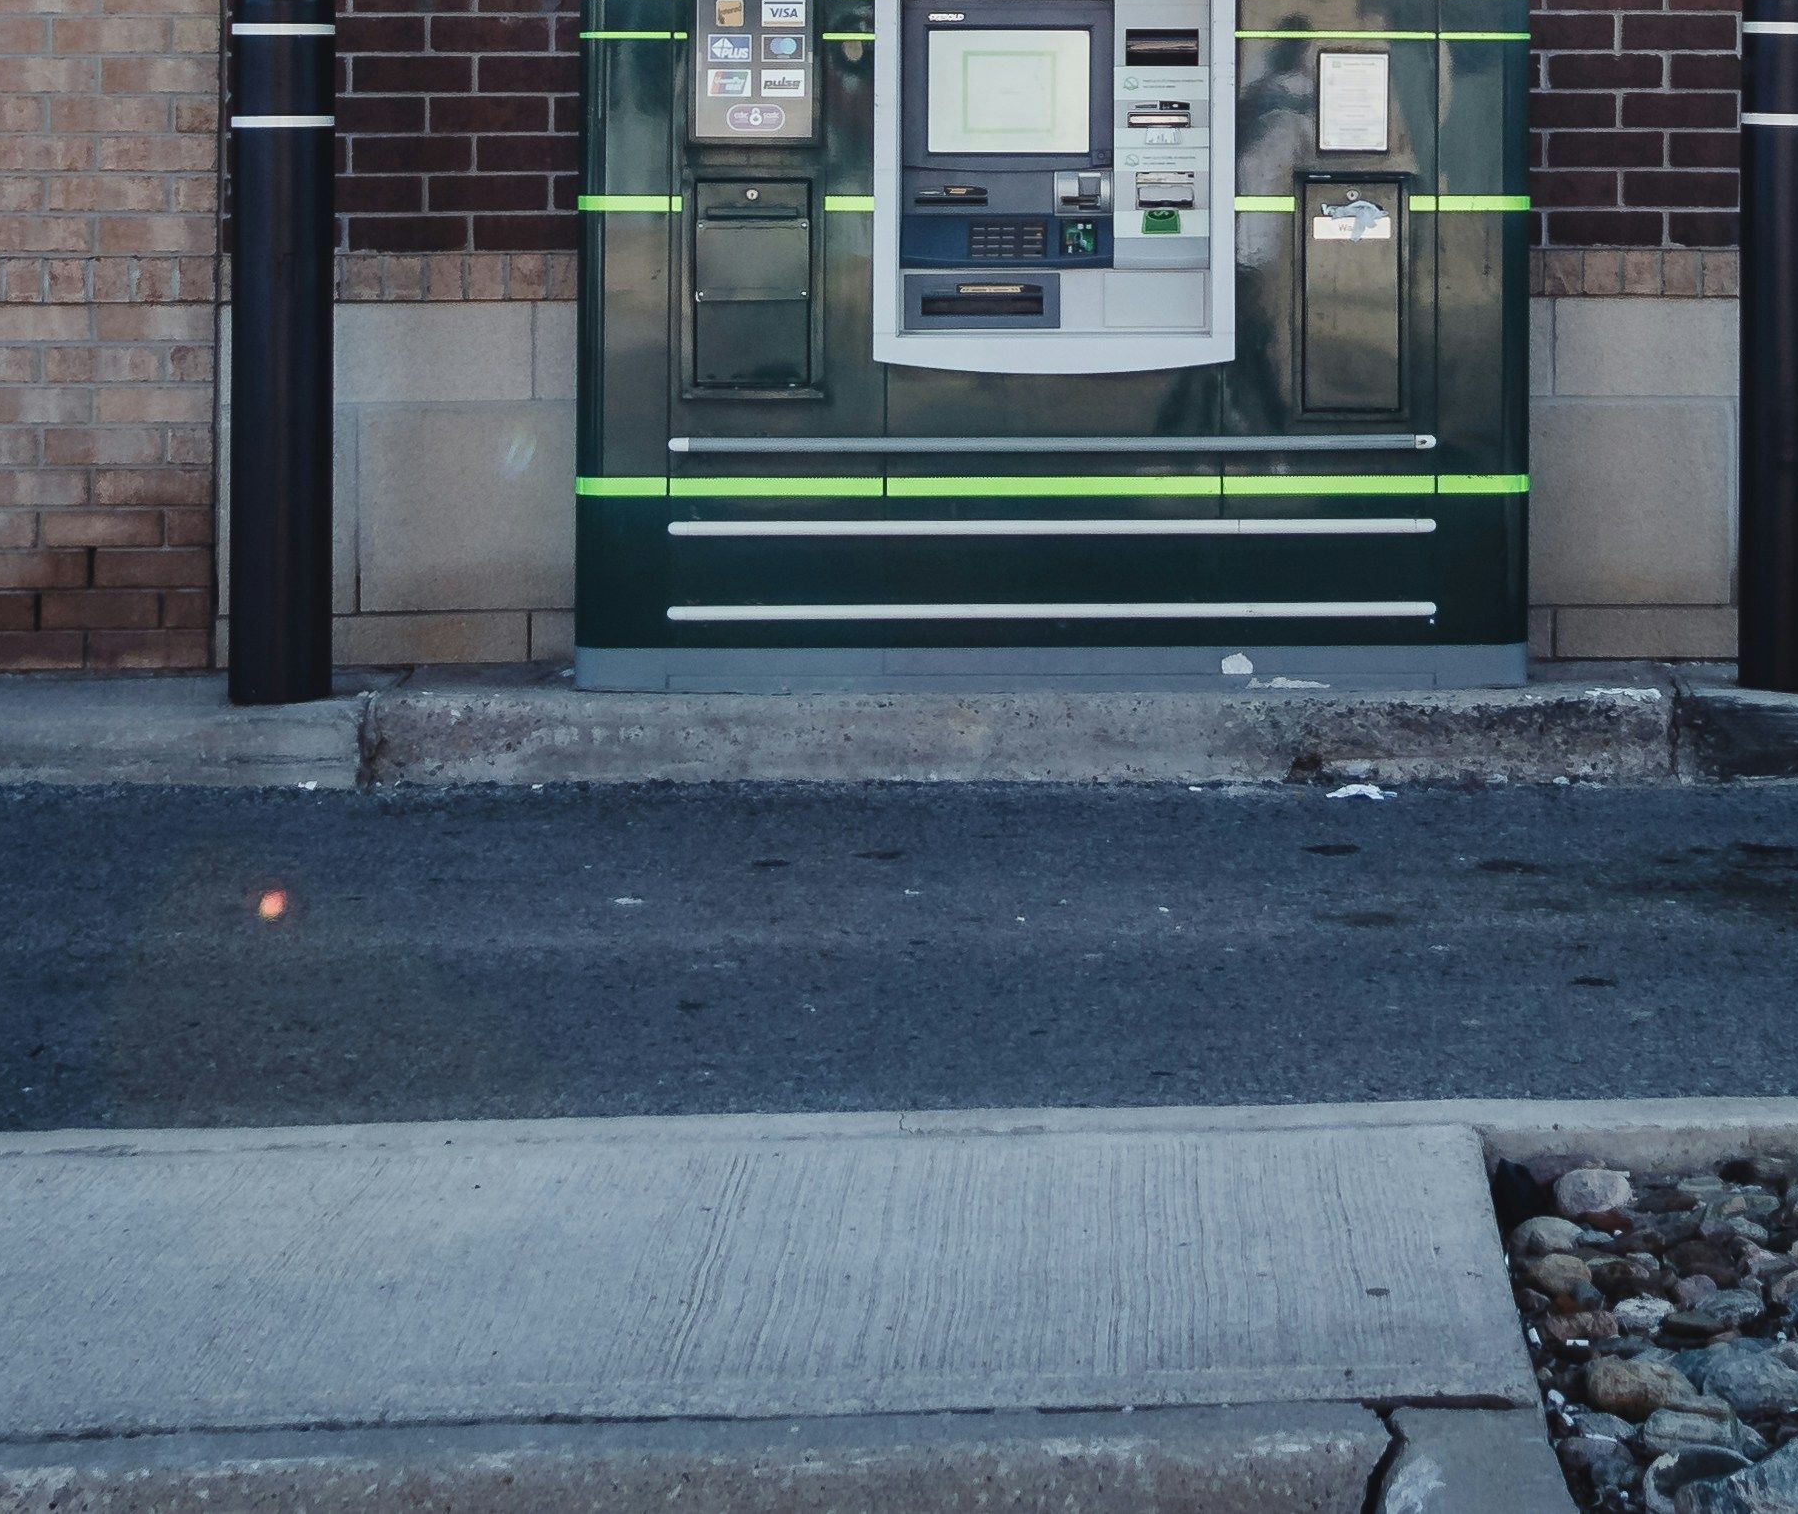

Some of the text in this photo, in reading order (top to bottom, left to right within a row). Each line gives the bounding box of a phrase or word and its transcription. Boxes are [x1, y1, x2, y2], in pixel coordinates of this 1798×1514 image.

[769, 7, 799, 18] VISA
[720, 47, 749, 59] PLUS
[763, 76, 801, 90] pulse
